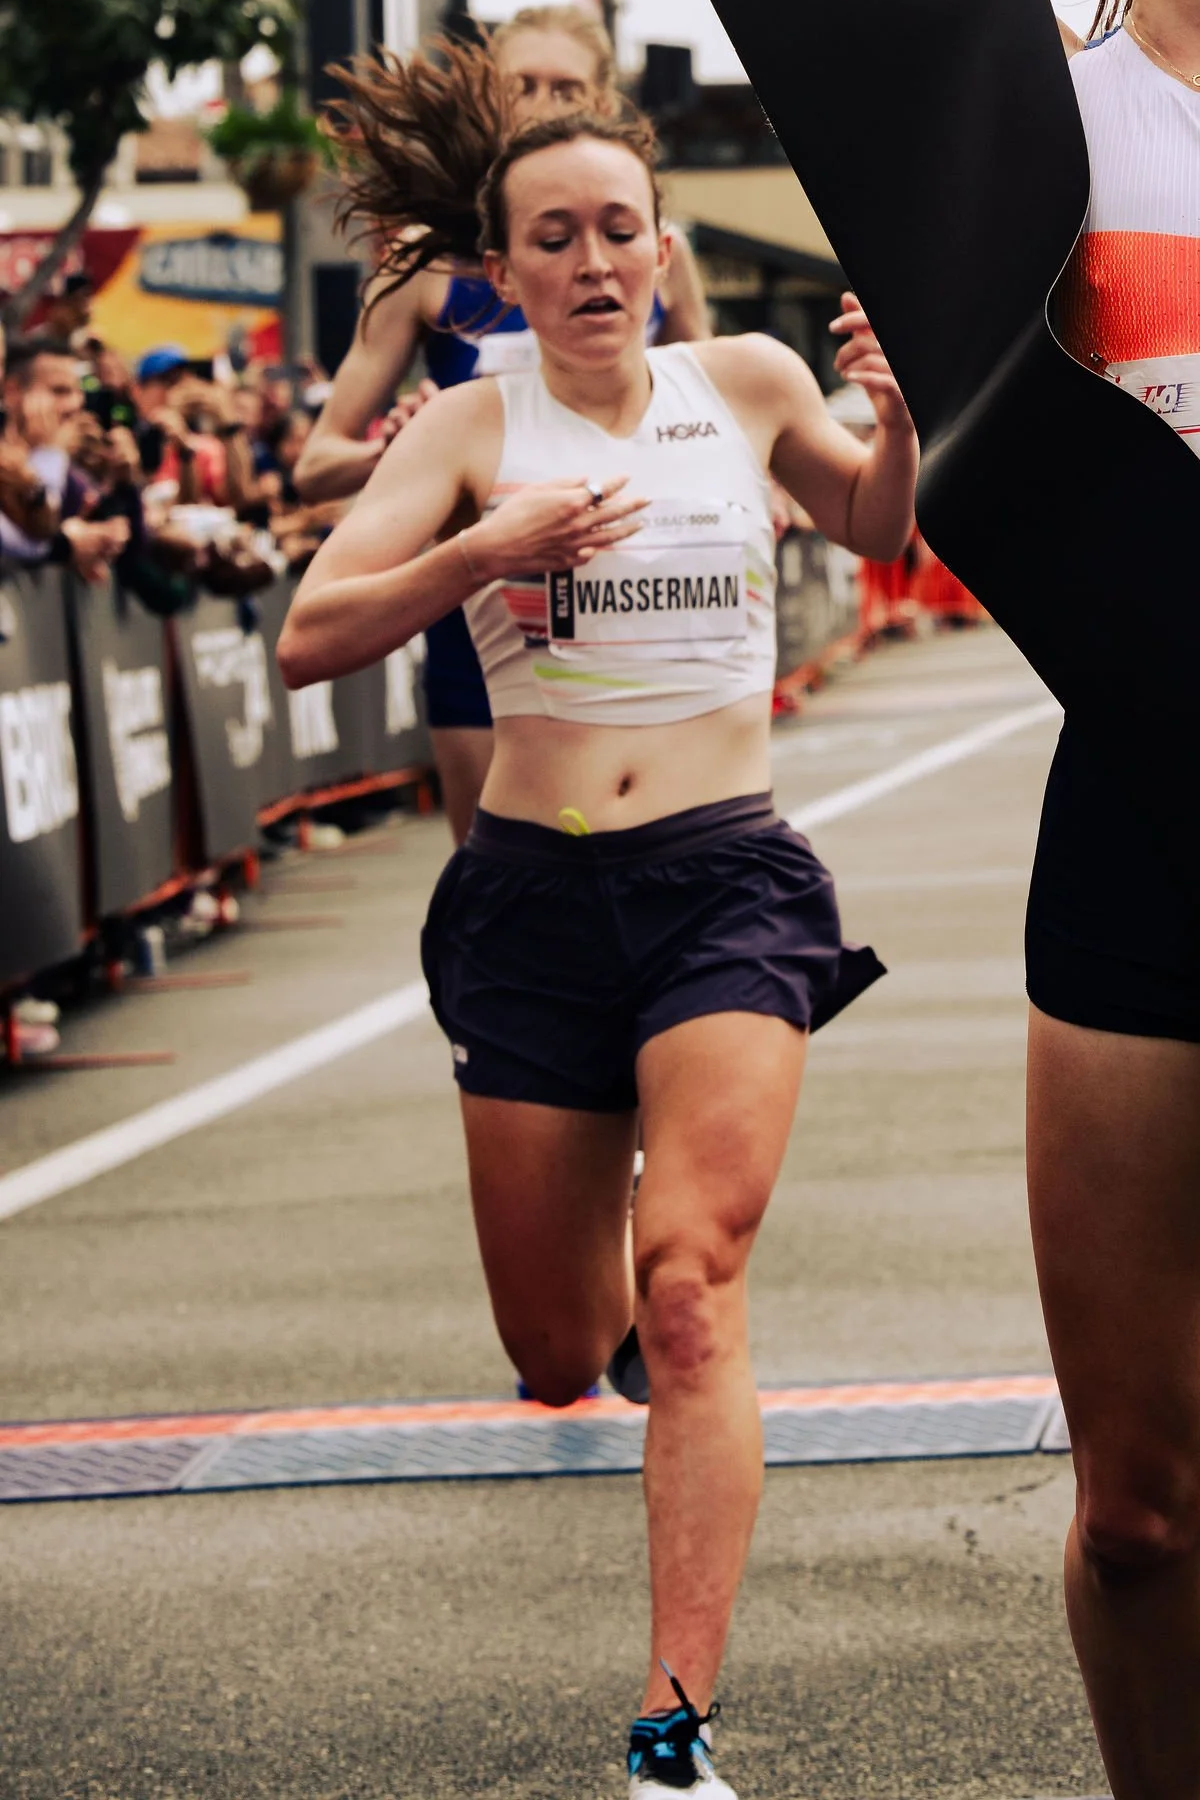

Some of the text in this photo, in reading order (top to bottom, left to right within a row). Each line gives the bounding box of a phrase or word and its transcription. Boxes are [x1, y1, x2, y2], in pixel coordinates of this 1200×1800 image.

[656, 421, 718, 443] HOKA
[556, 574, 739, 618] ELITE WASSERMAN
